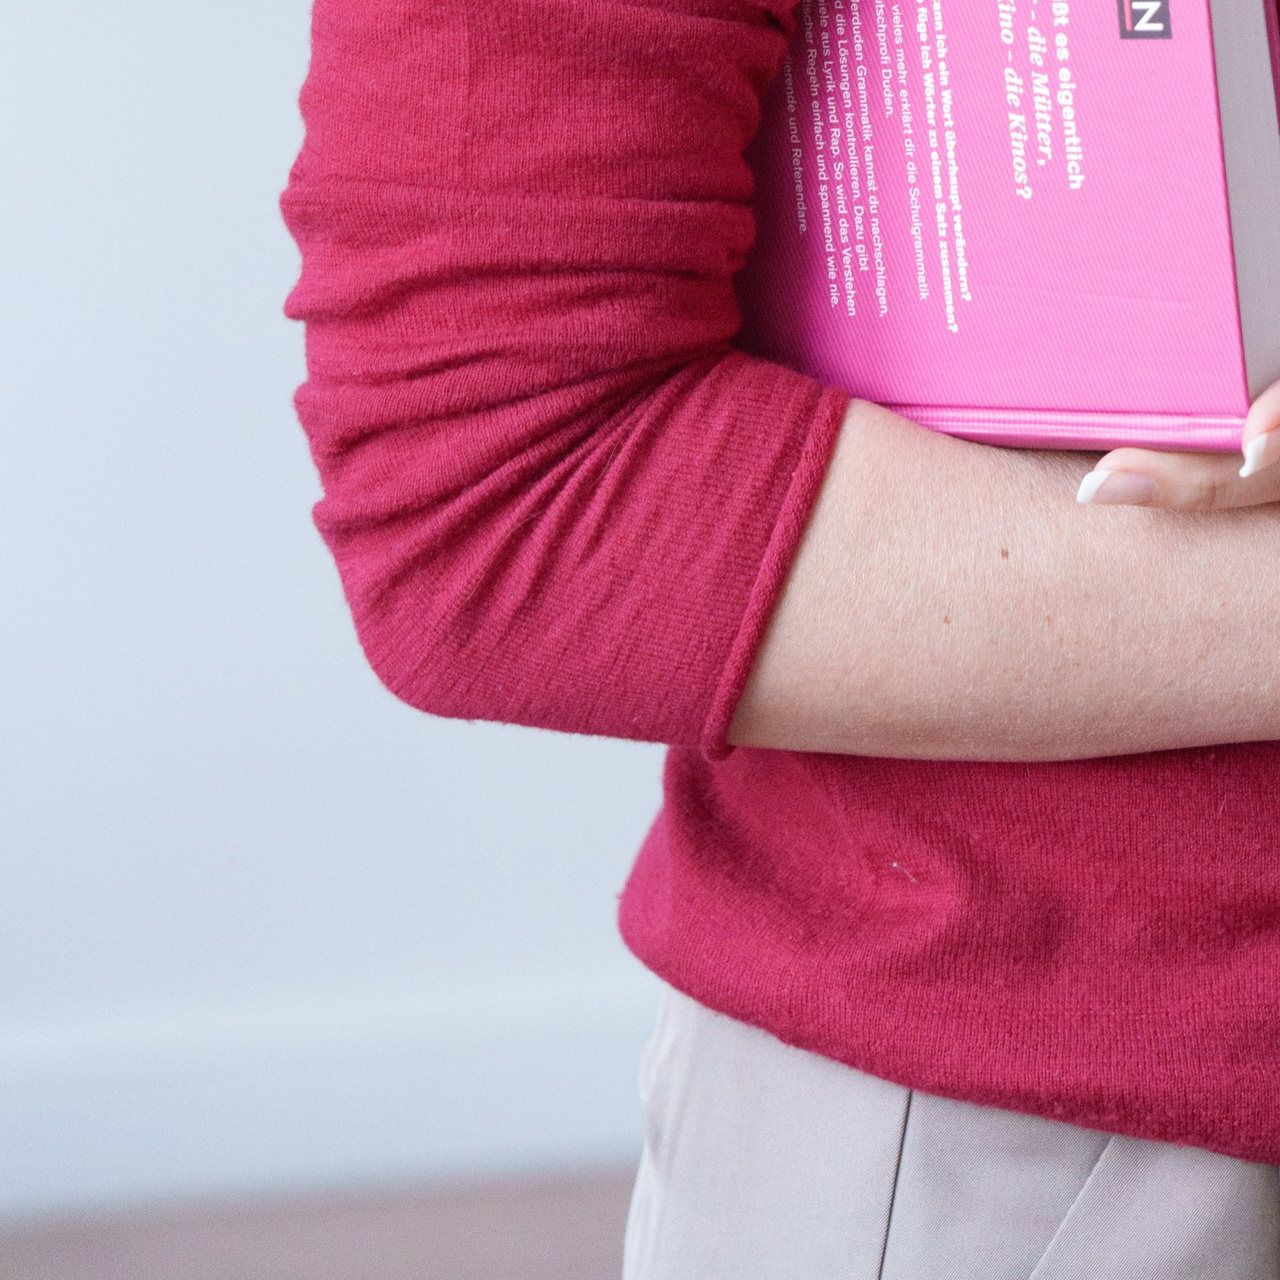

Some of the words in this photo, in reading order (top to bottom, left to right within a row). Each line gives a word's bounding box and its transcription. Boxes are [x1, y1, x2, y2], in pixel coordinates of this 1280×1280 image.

[836, 14, 846, 35] die
[892, 5, 904, 44] vieles
[917, 7, 928, 42] füge
[821, 32, 833, 56] aus
[921, 46, 932, 69] ich
[936, 35, 946, 57] ich
[1027, 26, 1046, 66] die
[1054, 33, 1068, 60] es
[806, 49, 819, 95] Regeln
[822, 61, 836, 92] Lyrik
[839, 40, 855, 108] Lösungen
[896, 49, 907, 85] mehr
[939, 61, 949, 85] ein
[857, 65, 873, 141] Grammatik
[881, 69, 894, 118] Duden.
[923, 72, 937, 126] Wörter
[1004, 67, 1022, 107] die
[812, 101, 825, 150] einfach
[827, 97, 838, 123] und
[899, 89, 913, 134] erklärt
[941, 89, 954, 127] Wort
[1031, 73, 1053, 166] Mütter,
[789, 118, 799, 143] und
[830, 128, 841, 157] Rap.
[929, 129, 938, 147] zu
[1056, 67, 1084, 189] eigentlich
[846, 113, 861, 201] kontrollieren.
[904, 139, 915, 157] dir
[1008, 112, 1031, 199] Kinos?
[817, 155, 827, 180] und
[834, 162, 844, 180] So
[864, 146, 877, 192] kannst
[907, 162, 917, 183] die
[931, 151, 942, 198] einem
[945, 131, 962, 211] überhaupt
[792, 148, 808, 235] Referendare.
[836, 184, 847, 213] wird
[869, 196, 879, 213] du
[818, 184, 835, 251] spannend
[839, 219, 851, 243] das
[854, 206, 865, 239] Dazu
[935, 203, 946, 237] Satz
[856, 245, 869, 271] gibt
[909, 188, 929, 300] Schulgrammatik
[953, 214, 971, 301] verändern?
[827, 256, 838, 279] wie
[842, 247, 857, 316] Verstehen
[871, 218, 888, 317] nachschlagen,
[830, 284, 841, 308] nie.
[939, 241, 958, 333] zusammen?
